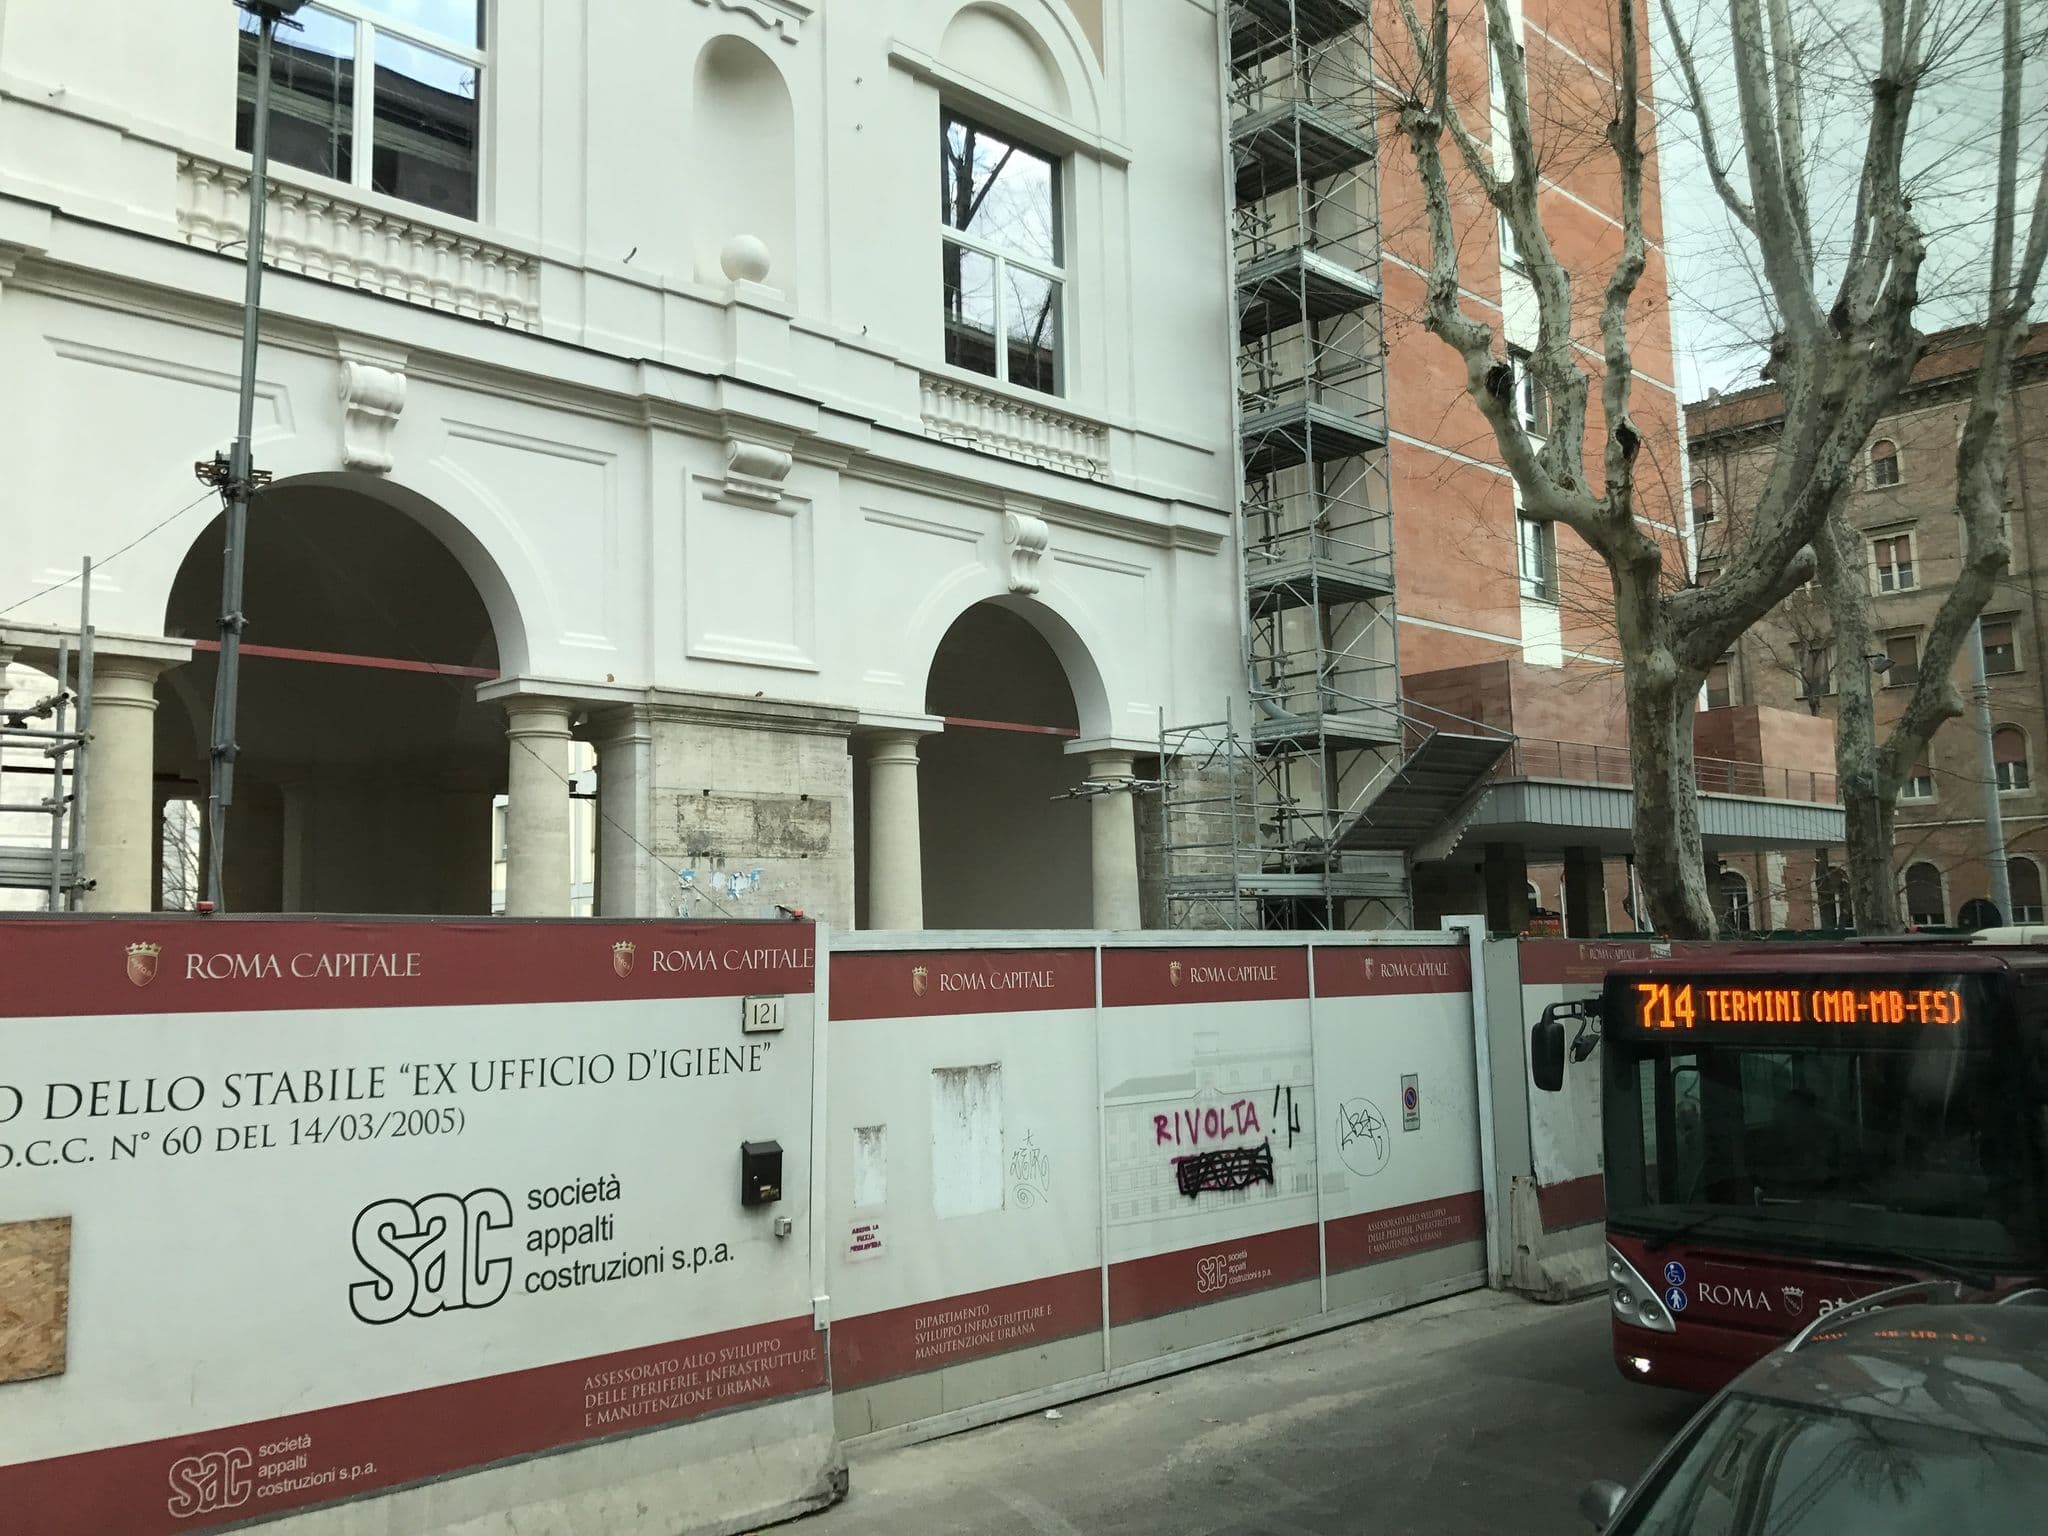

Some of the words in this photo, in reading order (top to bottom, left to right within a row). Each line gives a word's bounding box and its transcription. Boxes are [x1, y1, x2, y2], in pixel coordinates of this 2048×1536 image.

[186, 953, 282, 979] ROMA
[291, 953, 421, 978] CAPITALE
[652, 950, 717, 972] ROMA
[723, 948, 814, 970] CAPITALE
[1190, 967, 1225, 983] ROMA
[1227, 965, 1277, 981] CAPITALE
[1381, 963, 1409, 977] ROMA
[1410, 962, 1449, 976] CAPITALE
[940, 973, 986, 992] ROMA
[989, 971, 1054, 990] CAPITALE
[753, 1003, 777, 1025] 121
[1638, 983, 1695, 1028] 714
[1706, 990, 1801, 1022] TERMINI
[1812, 990, 1961, 1024] (MA-MB-FS)
[43, 1076, 205, 1120] DELLO
[222, 1066, 386, 1109] STABILE
[400, 1062, 457, 1097] “EX
[470, 1053, 615, 1093] UFFICIO
[110, 1131, 150, 1161] N°
[162, 1126, 202, 1156] 60
[215, 1124, 276, 1152] DEL
[289, 1107, 466, 1146] 14/03/2005)
[1153, 1099, 1261, 1146] RIVOLTA
[527, 1174, 622, 1211] società
[526, 1214, 615, 1256] appalti
[349, 1187, 513, 1325] sac
[525, 1248, 664, 1294] costruzioni
[672, 1241, 735, 1273] s.p.a.
[1228, 1249, 1247, 1261] società
[1228, 1262, 1247, 1274] appalti
[1197, 1255, 1228, 1293] sac
[1699, 1282, 1772, 1312] ROMA
[915, 1304, 990, 1330] DIPARTIMENTO
[915, 1325, 961, 1345] SVILUPPO
[964, 1306, 1044, 1334] INFRASTRUTTURE
[1047, 1304, 1052, 1315] E
[915, 1332, 995, 1360] MANUTENZIONE
[997, 1322, 1035, 1340] URBANA
[584, 1358, 678, 1391] ASSESSORATO
[682, 1351, 716, 1370] ALLO
[720, 1338, 781, 1362] SVILUPPO
[585, 1386, 627, 1408] DELLE
[706, 1348, 817, 1383] INFRASTRUTTURE
[585, 1413, 592, 1427] E
[597, 1388, 713, 1425] MANUTENZIONE
[716, 1376, 771, 1398] URBANA
[258, 1434, 312, 1457] società
[168, 1447, 252, 1518] sac
[257, 1453, 307, 1479] appalti
[257, 1467, 335, 1498] costruzioni
[339, 1461, 377, 1481] s.p.a.
